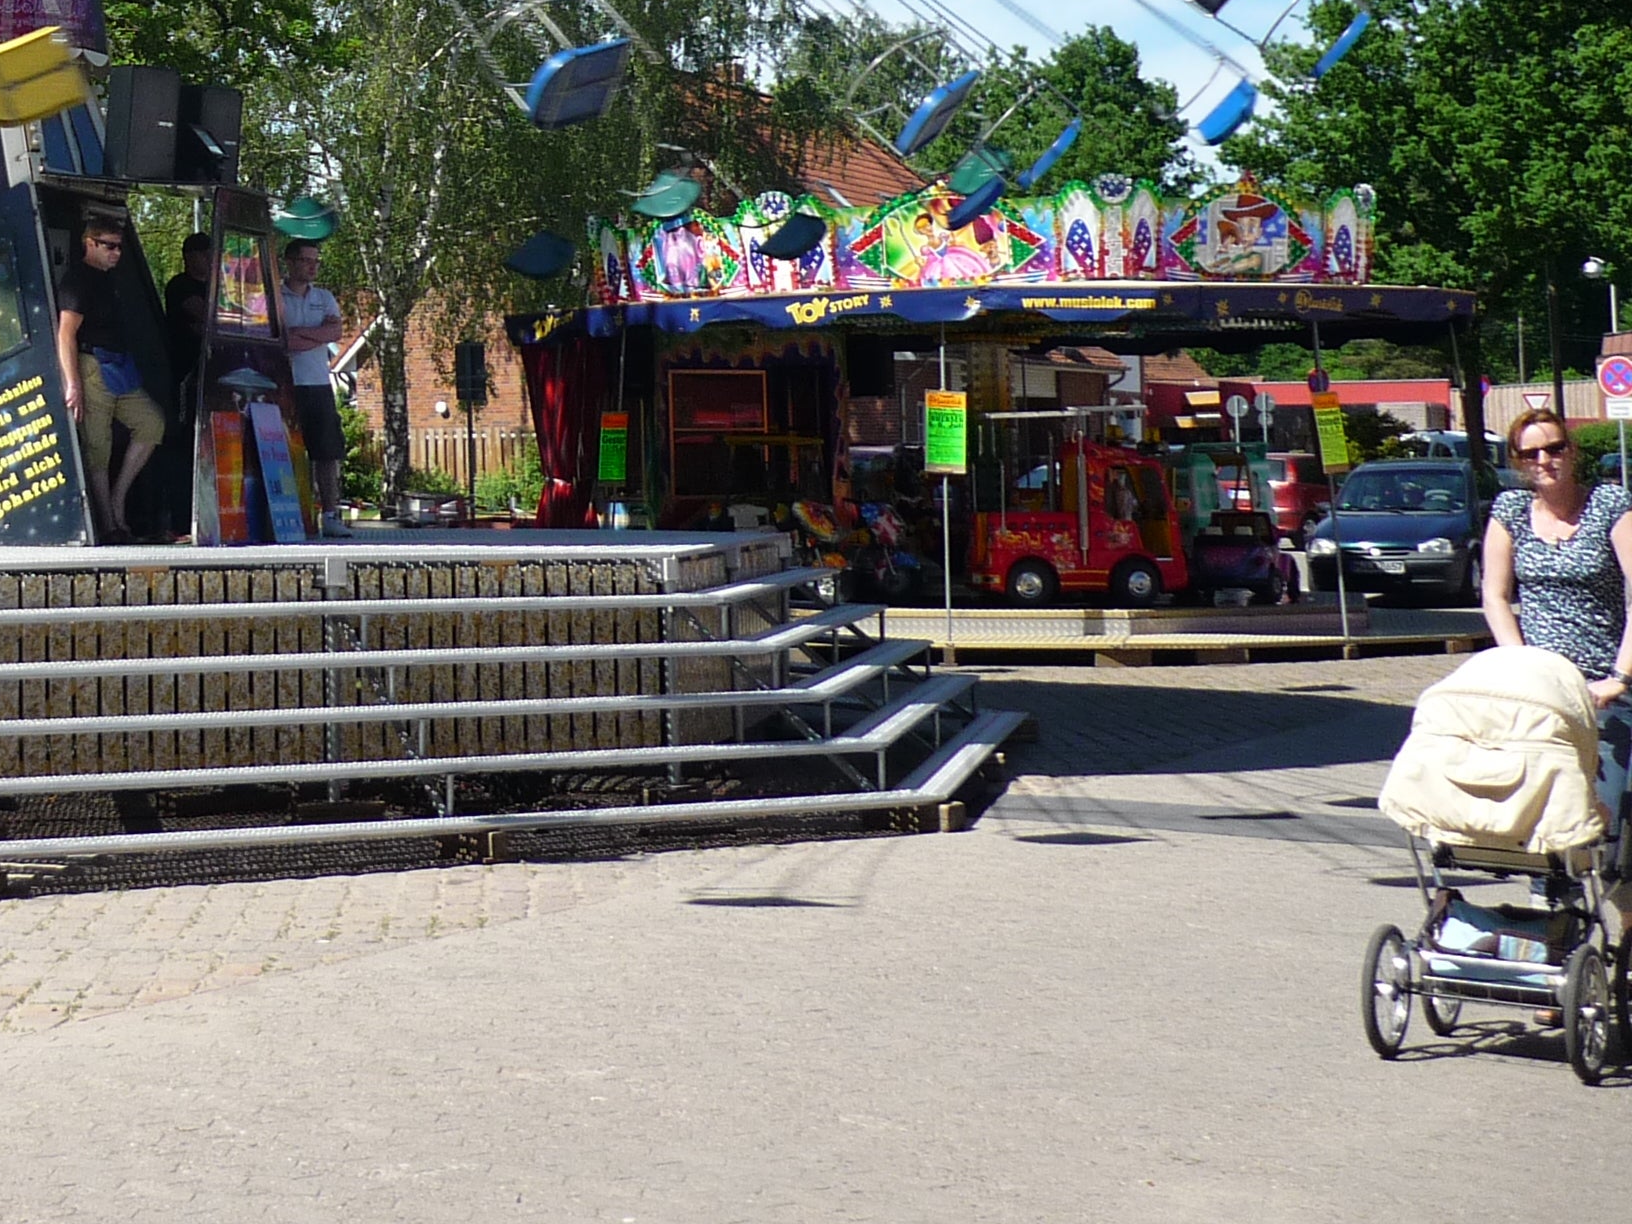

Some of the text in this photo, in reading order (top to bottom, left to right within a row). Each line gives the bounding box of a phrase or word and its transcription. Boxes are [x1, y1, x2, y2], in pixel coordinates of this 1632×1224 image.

[785, 294, 869, 325] TOY STORY
[1021, 296, 1157, 309] www.musiolek.com
[17, 393, 47, 416] und
[23, 451, 63, 480] nicht
